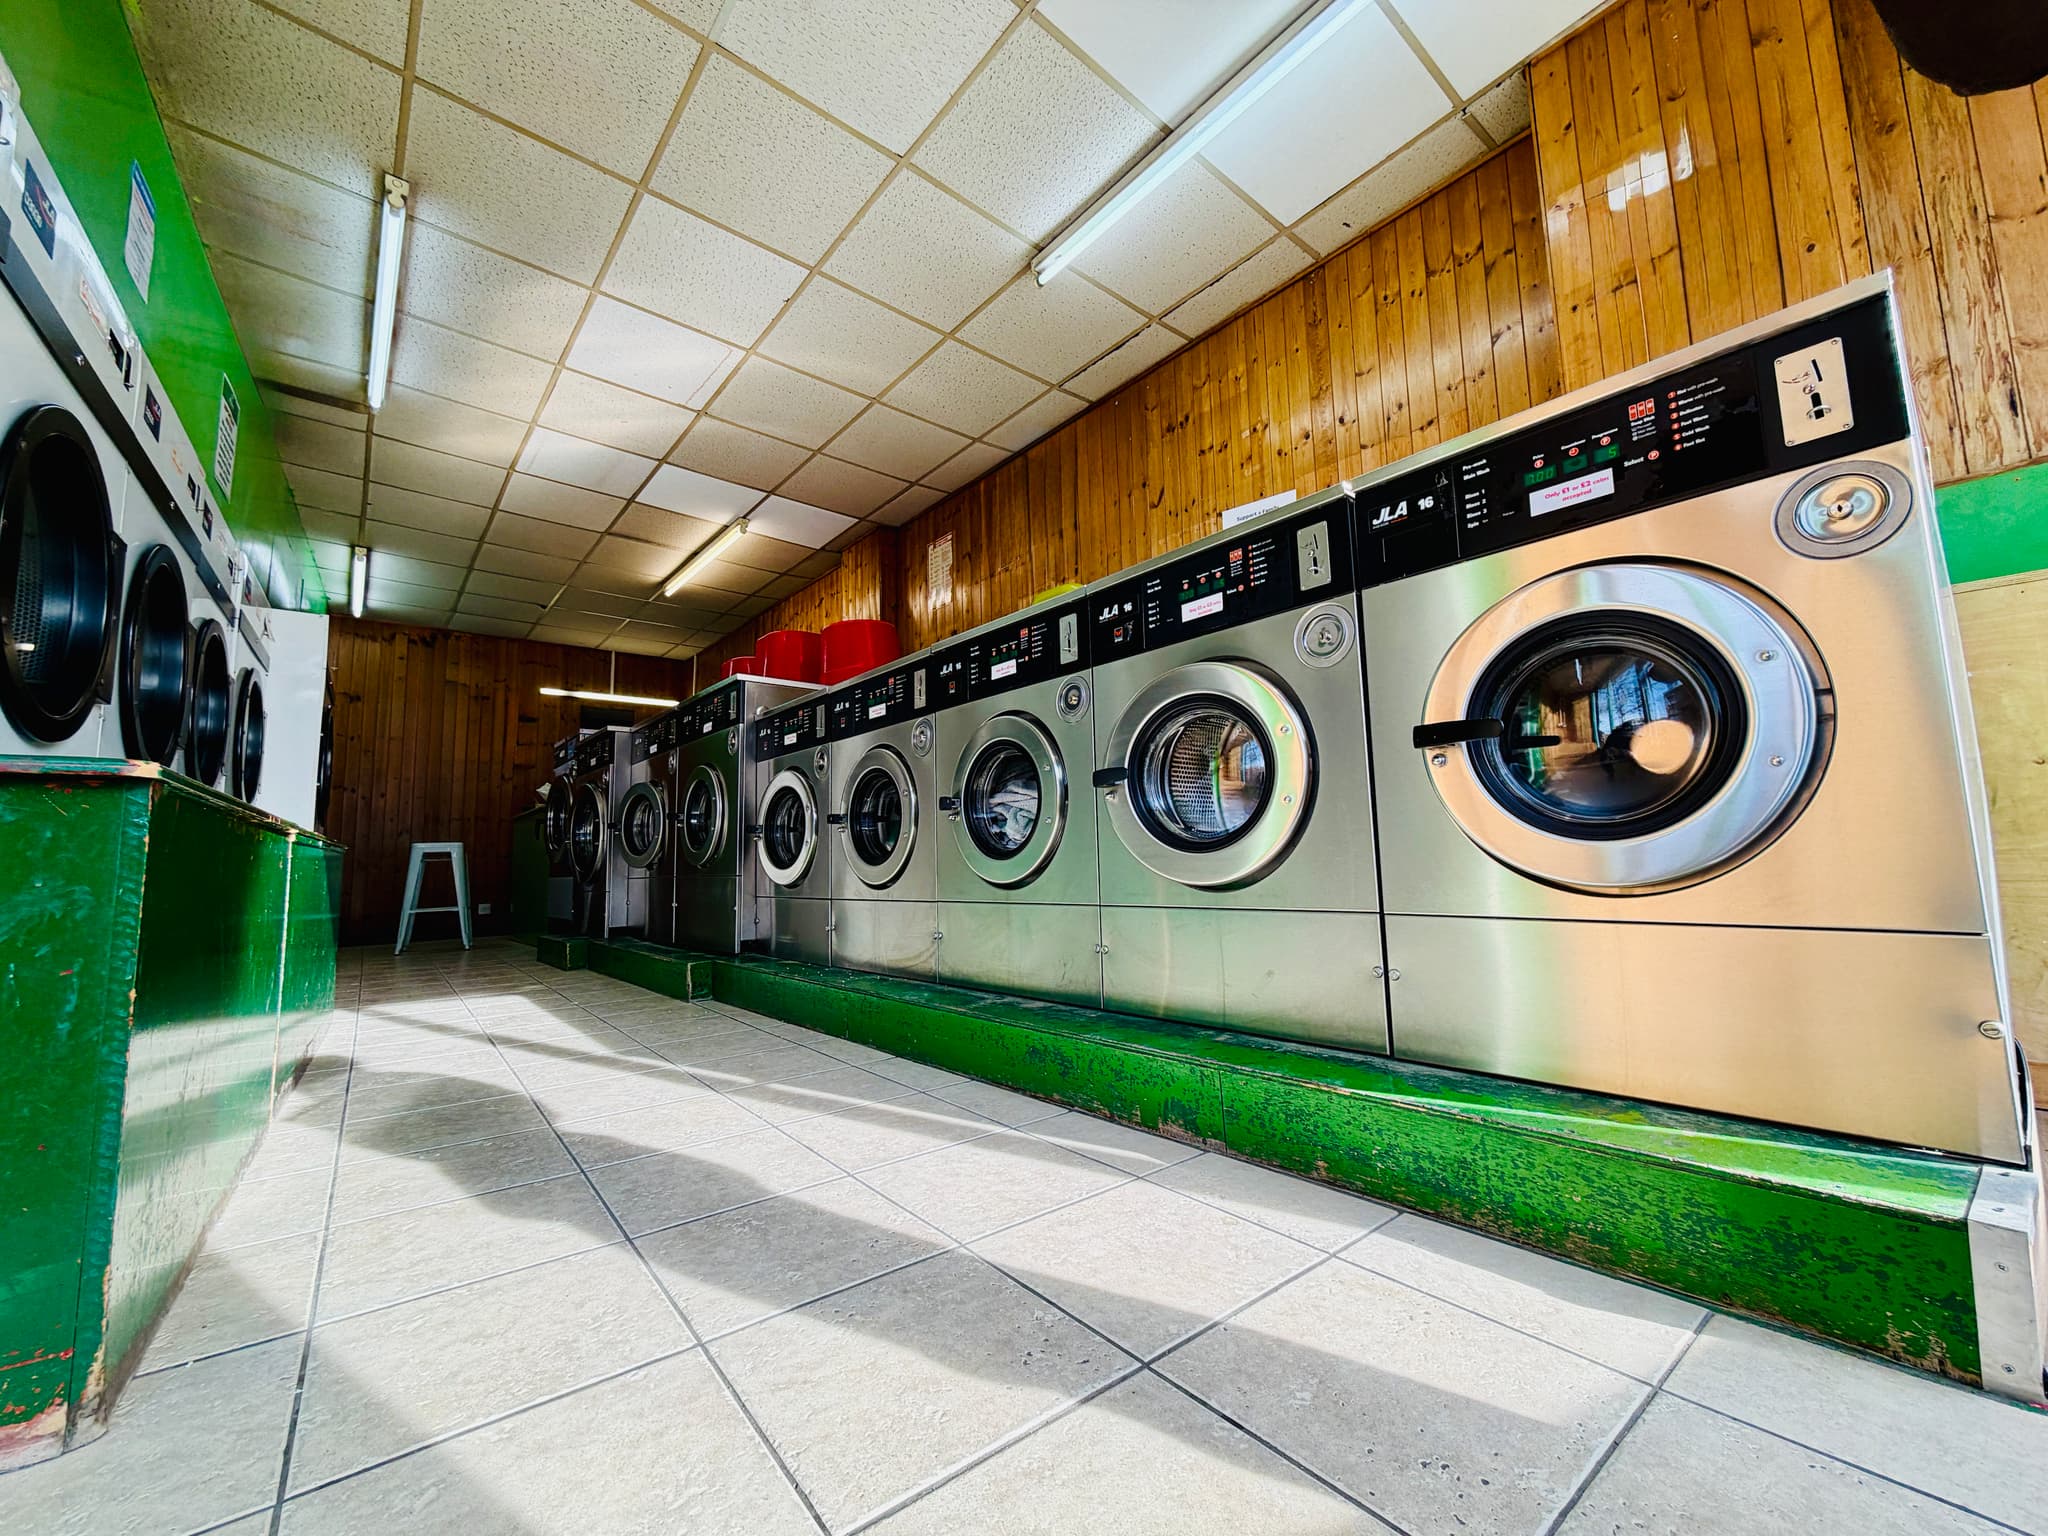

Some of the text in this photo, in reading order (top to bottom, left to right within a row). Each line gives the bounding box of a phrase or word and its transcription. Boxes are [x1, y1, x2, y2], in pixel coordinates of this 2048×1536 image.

[1544, 491, 1560, 500] Only
[1561, 486, 1570, 494] £1
[1372, 500, 1408, 526] JLA
[1417, 496, 1434, 511] 16
[1099, 602, 1133, 621] JLA 16
